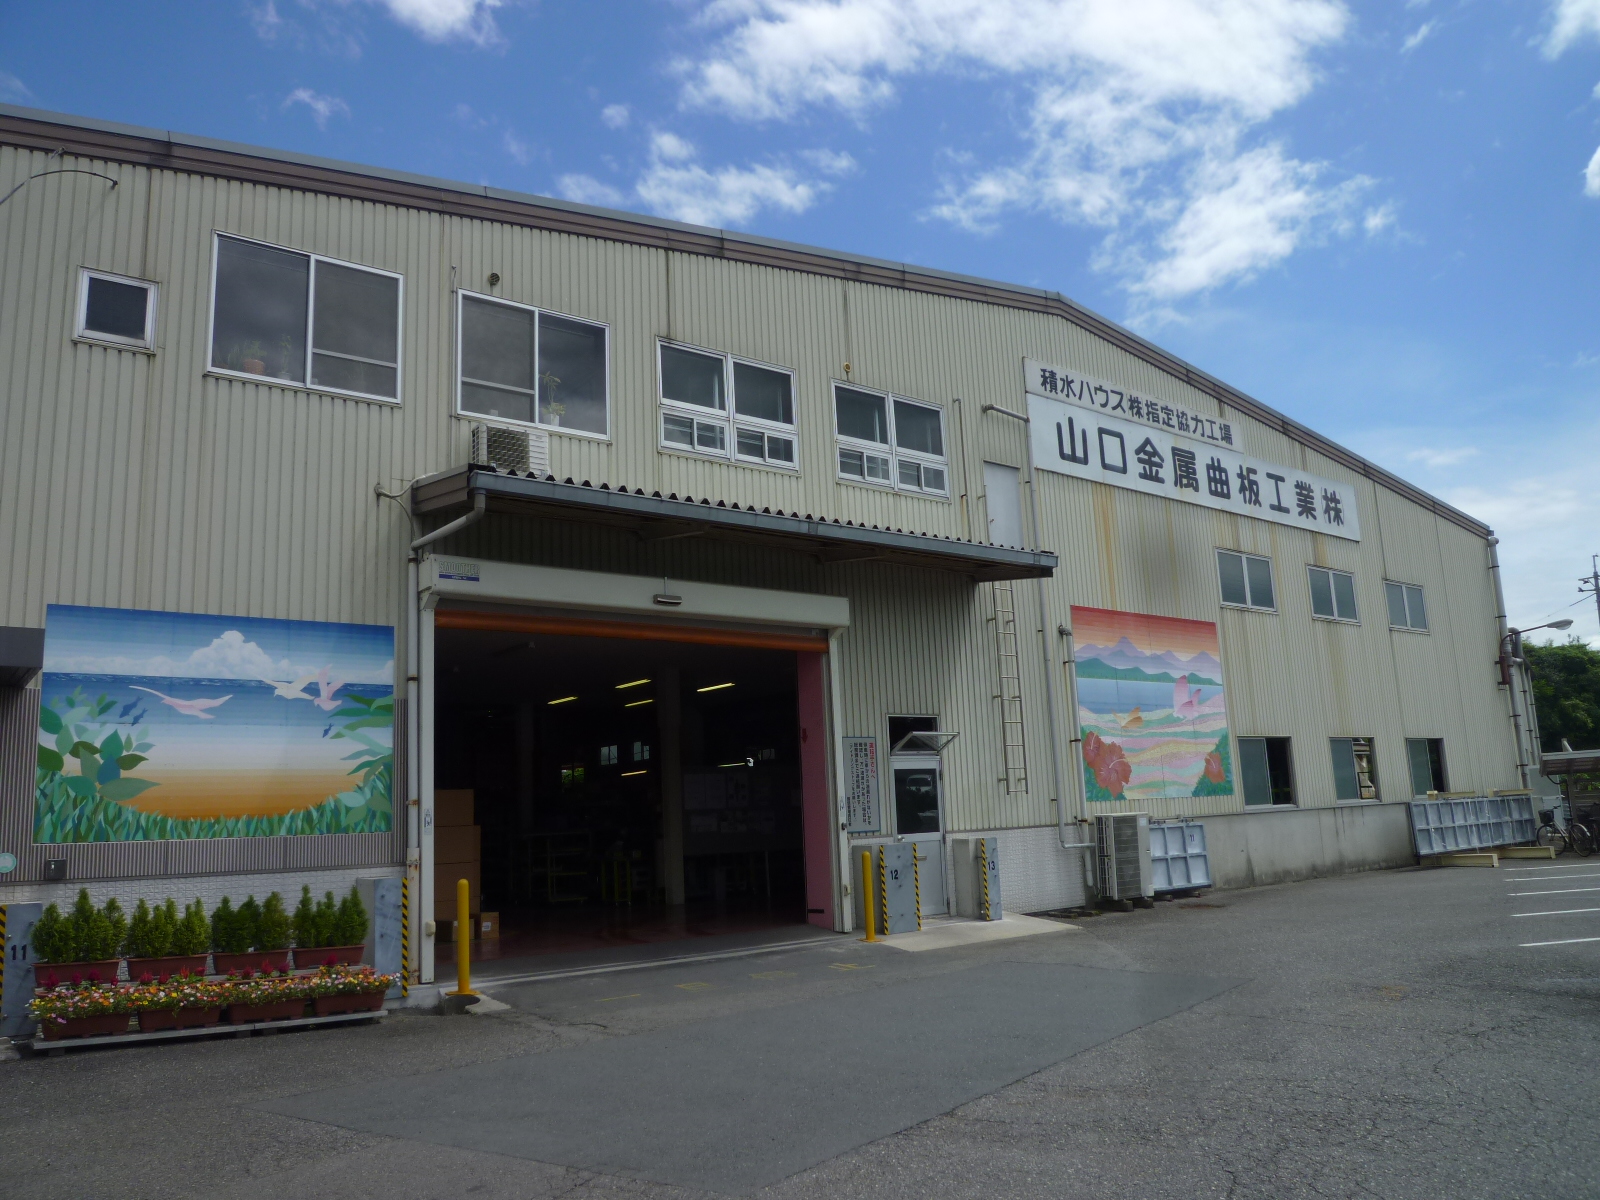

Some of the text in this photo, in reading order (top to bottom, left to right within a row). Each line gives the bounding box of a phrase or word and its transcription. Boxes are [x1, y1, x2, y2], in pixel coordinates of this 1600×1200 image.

[988, 861, 996, 871] 13
[890, 869, 899, 880] 12
[11, 944, 27, 960] 11
